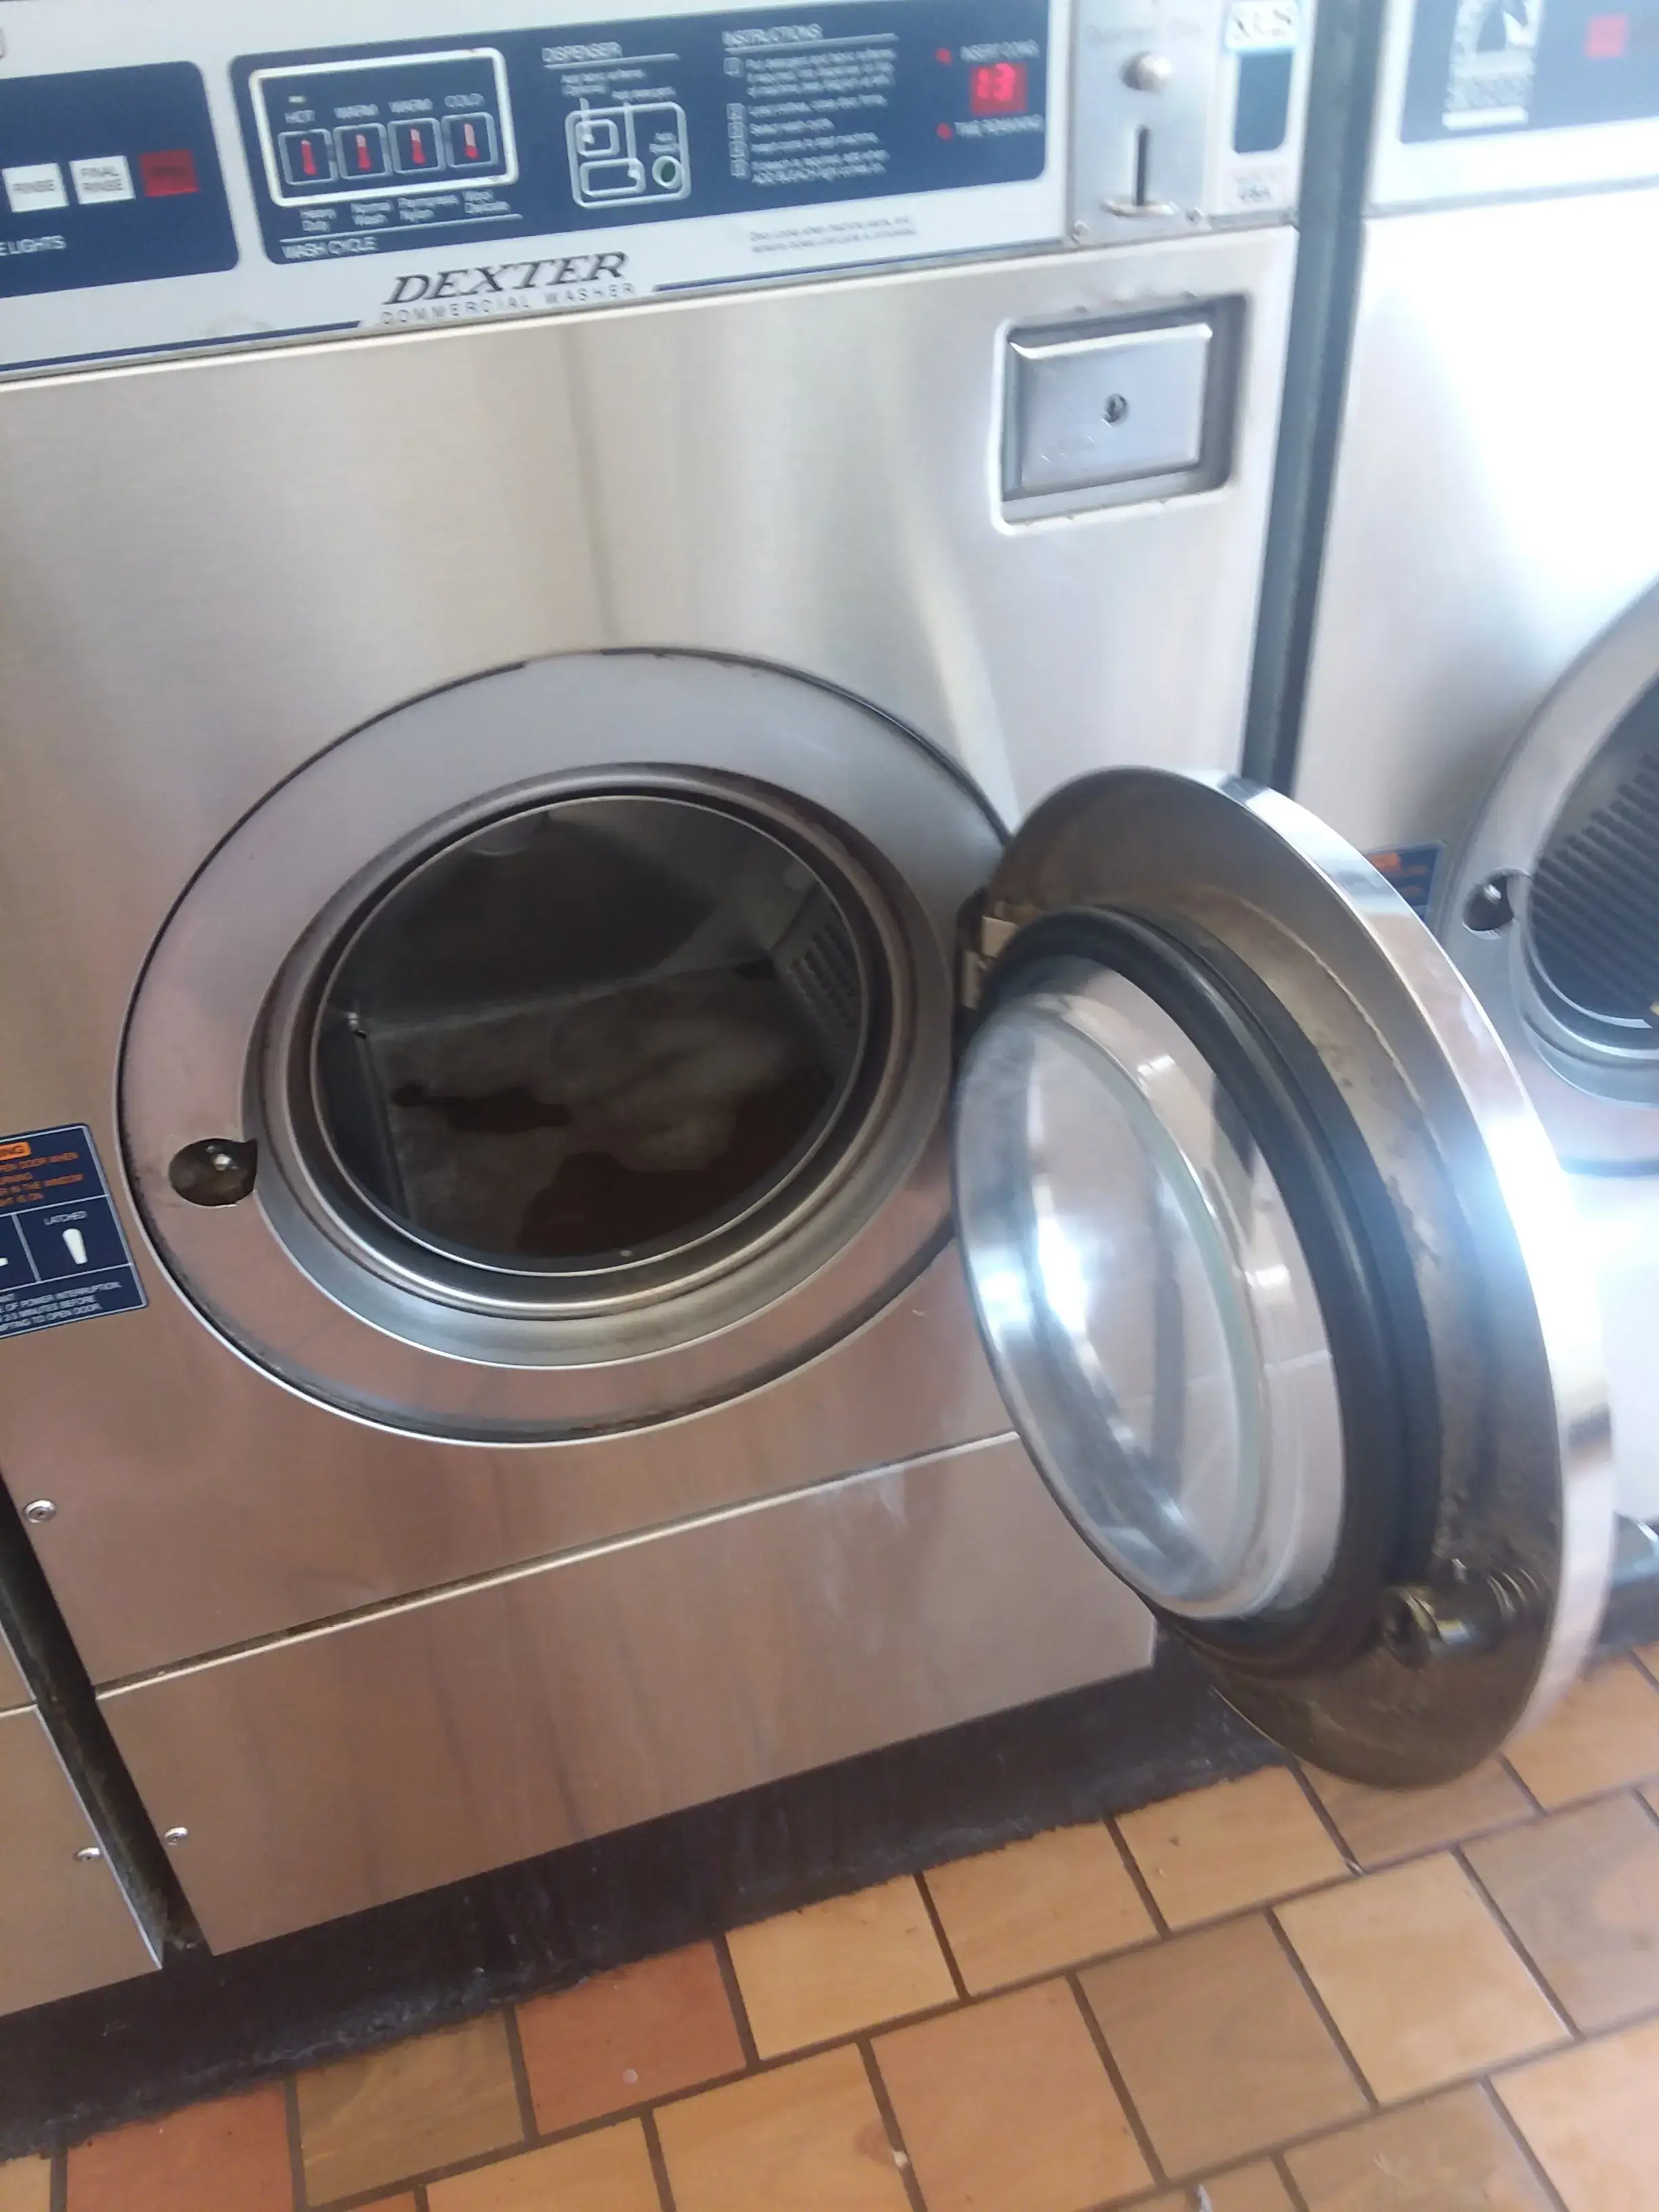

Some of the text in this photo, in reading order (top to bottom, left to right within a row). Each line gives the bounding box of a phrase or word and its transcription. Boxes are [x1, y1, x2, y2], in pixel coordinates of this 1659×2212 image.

[542, 42, 622, 62] DISPENSER
[444, 93, 485, 108] COLD
[80, 166, 119, 177] FINAL
[13, 179, 54, 194] RINSE
[83, 178, 123, 193] RINSE
[8, 235, 66, 254] LIGHTS
[281, 237, 380, 259] WASH CYCLE
[383, 251, 628, 305] DEXTER
[380, 283, 636, 325] COMMERCIAL WASHER
[44, 1210, 87, 1225] LATCHED
[5, 1302, 18, 1312] OF
[20, 1294, 55, 1309] POWER
[60, 1294, 96, 1309] BEFORE
[32, 1315, 46, 1324] TO
[47, 1309, 72, 1321] OPEN
